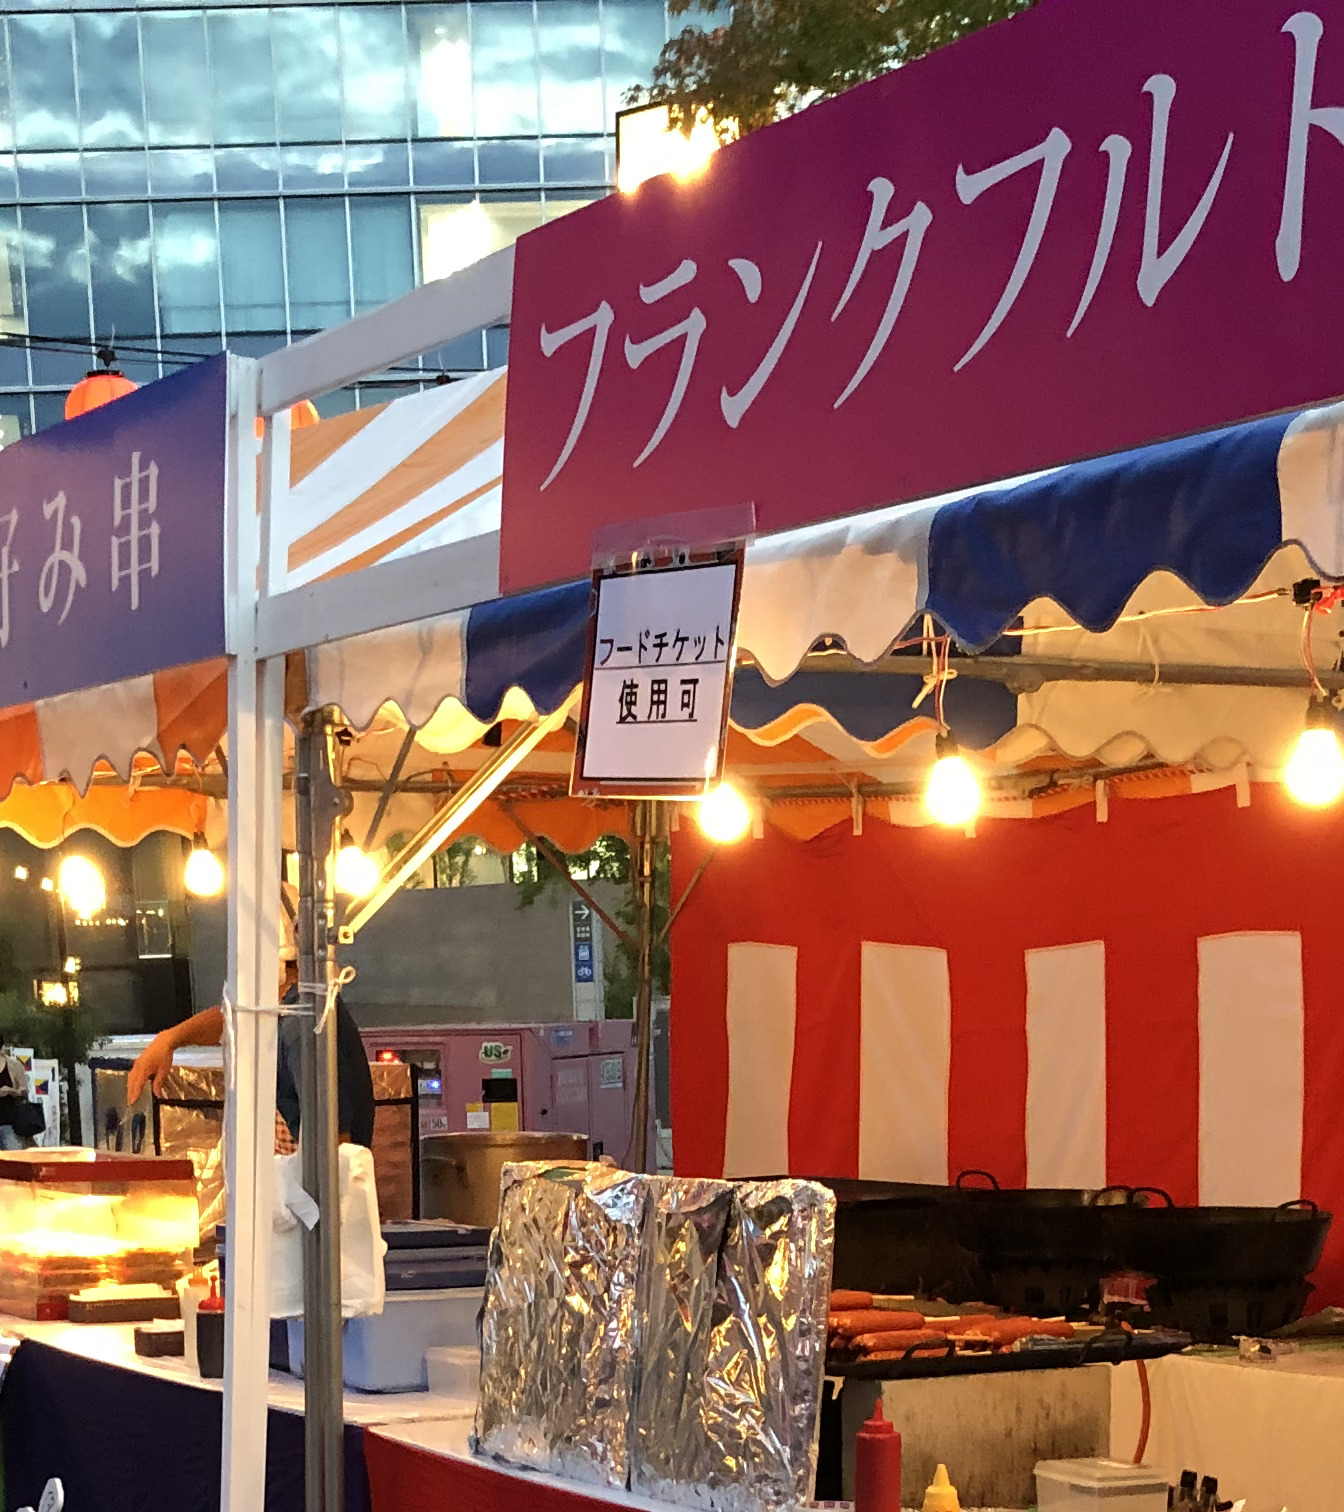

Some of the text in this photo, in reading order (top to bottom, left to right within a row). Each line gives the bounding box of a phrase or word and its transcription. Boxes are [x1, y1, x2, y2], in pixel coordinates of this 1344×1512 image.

[599, 624, 725, 666] フードチケット
[618, 678, 700, 724] 使用可
